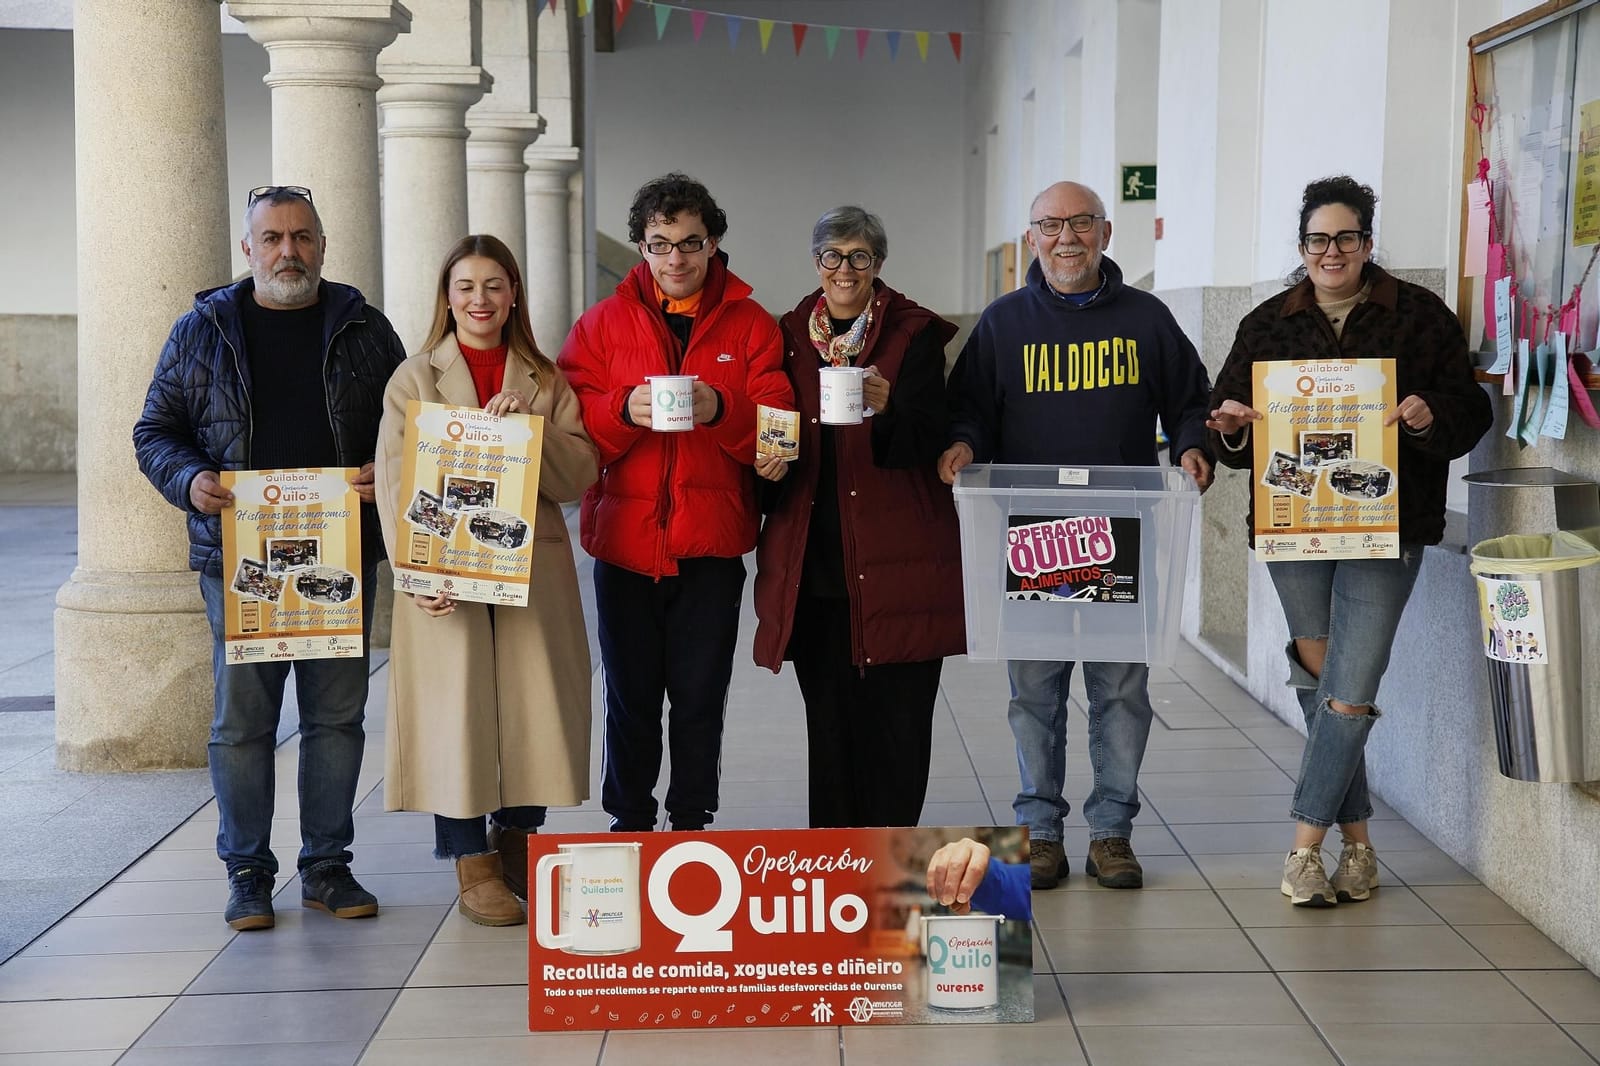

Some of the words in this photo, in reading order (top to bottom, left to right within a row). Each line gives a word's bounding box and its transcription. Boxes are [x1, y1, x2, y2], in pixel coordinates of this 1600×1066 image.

[1024, 336, 1140, 393] VALDOCCO
[1296, 376, 1341, 396] Quilo
[1268, 402, 1314, 413] Historias
[1317, 402, 1328, 412] de
[1330, 402, 1387, 414] compromiso
[450, 411, 502, 423] Quilabora!
[1295, 414, 1364, 425] solidariedade
[447, 421, 489, 441] Quilo
[417, 441, 461, 456] Historias
[463, 450, 474, 458] de
[477, 451, 532, 465] compromiso
[442, 459, 508, 474] solidariedade
[266, 474, 317, 482] Quilabora!
[263, 485, 306, 504] Quilo
[236, 510, 281, 521] Historias
[283, 510, 294, 520] de
[296, 510, 350, 522] compromiso
[1302, 503, 1344, 514] Campaña
[1347, 504, 1356, 512] de
[1358, 503, 1395, 511] recollida
[1302, 515, 1312, 523] de
[1314, 512, 1353, 522] alimentos
[262, 522, 329, 532] solidariedade
[1008, 516, 1108, 545] OPERACIÓN
[439, 544, 480, 559] Campaña
[481, 550, 491, 558] de
[493, 552, 528, 562] recollida
[1010, 531, 1113, 575] QUILO
[450, 557, 488, 569] alimentos
[1020, 567, 1102, 591] ALIMENTOS
[270, 607, 309, 619] Campaña
[323, 607, 359, 615] recollida
[269, 620, 279, 628] de
[281, 618, 319, 626] alimentos
[743, 845, 873, 883] Operación
[581, 886, 623, 894] Quilabora
[648, 841, 869, 952] Quilo
[949, 937, 993, 950] Operación
[929, 935, 992, 974] Quilo
[543, 962, 628, 981] Recollida
[632, 962, 654, 979] de
[659, 961, 729, 980] comida,
[734, 961, 817, 980] xoguetes
[821, 962, 833, 976] e
[838, 959, 903, 976] diñeiro
[544, 987, 566, 998] Todo
[576, 989, 594, 999] que
[596, 986, 648, 996] recollemos
[662, 986, 698, 997] reparte
[699, 985, 725, 994] entre
[739, 983, 777, 993] familias
[779, 982, 848, 992] desfavorecidas
[850, 982, 861, 991] de
[863, 981, 903, 991] Ourense
[937, 982, 984, 993] ourense
